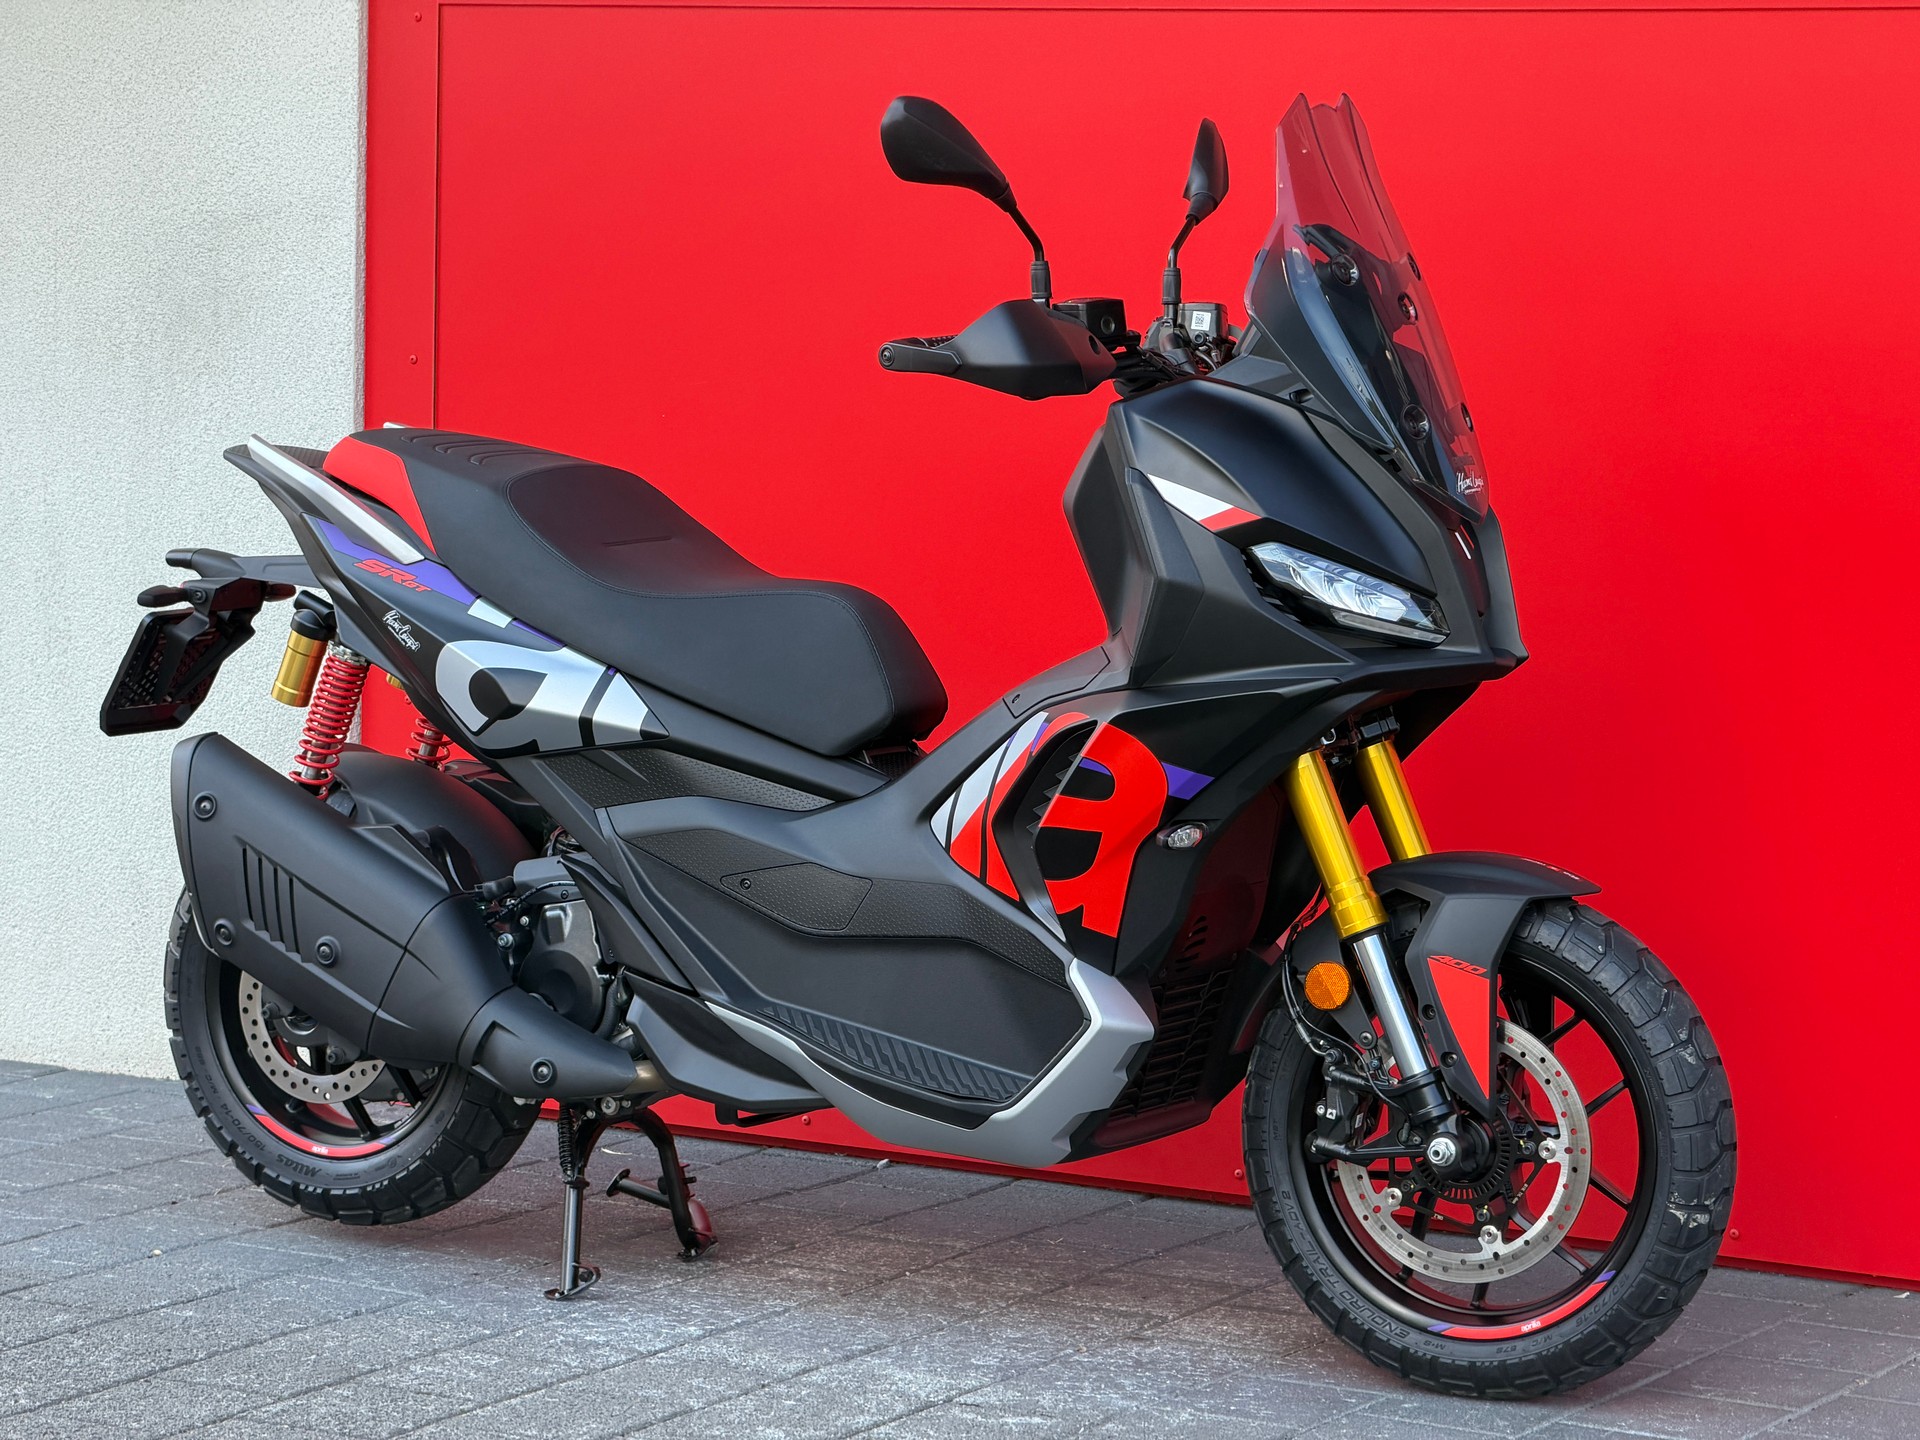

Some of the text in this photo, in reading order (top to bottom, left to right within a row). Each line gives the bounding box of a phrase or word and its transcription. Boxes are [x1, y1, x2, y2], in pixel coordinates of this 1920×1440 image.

[353, 559, 418, 585] SR
[1428, 955, 1488, 976] 400
[221, 1103, 267, 1152] 150/70-14
[275, 1153, 322, 1178] Mitas
[1338, 1288, 1411, 1343] ENDURO
